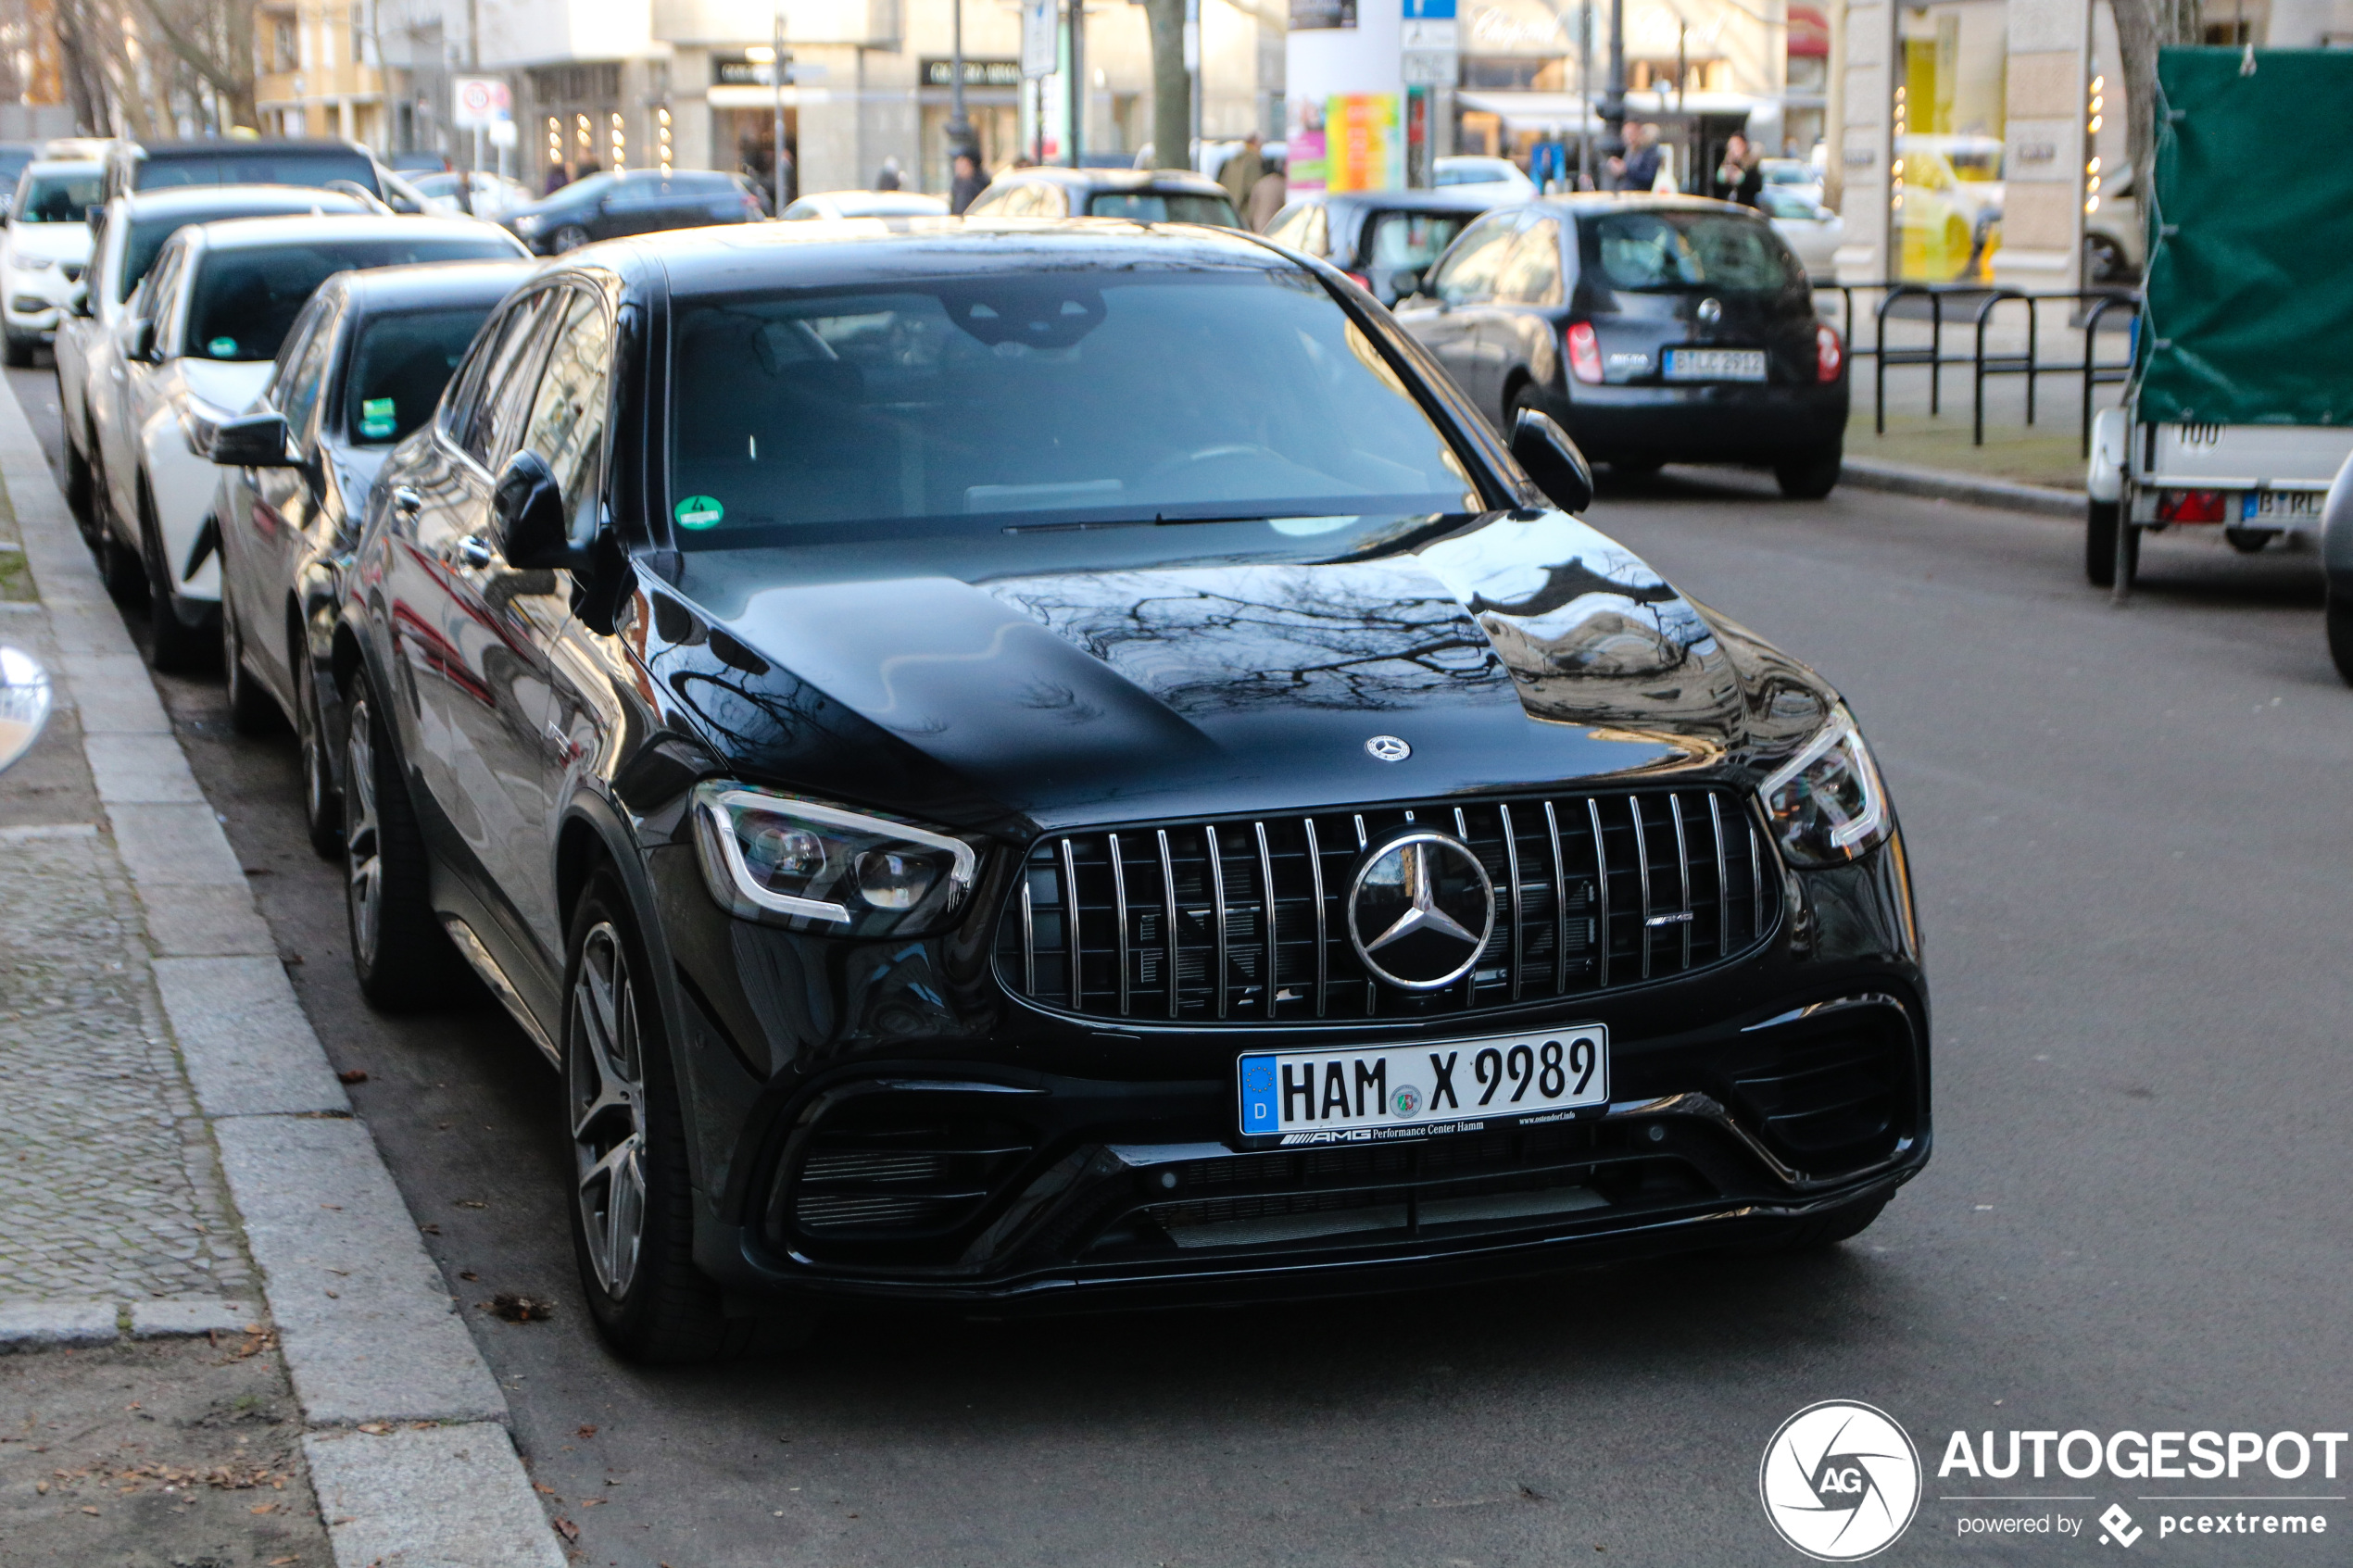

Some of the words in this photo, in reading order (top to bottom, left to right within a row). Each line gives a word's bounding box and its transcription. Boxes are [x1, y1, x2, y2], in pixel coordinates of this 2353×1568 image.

[1282, 1056, 1387, 1122] HAM
[1428, 1050, 1459, 1110] X
[1475, 1036, 1595, 1106] 9989
[1254, 1102, 1267, 1119] D
[1519, 1110, 1576, 1125] www.ostendorf.info
[1307, 1129, 1372, 1144] AMG
[1372, 1126, 1426, 1139] Performance
[1428, 1123, 1455, 1135] Center
[1457, 1121, 1484, 1132] Hamm
